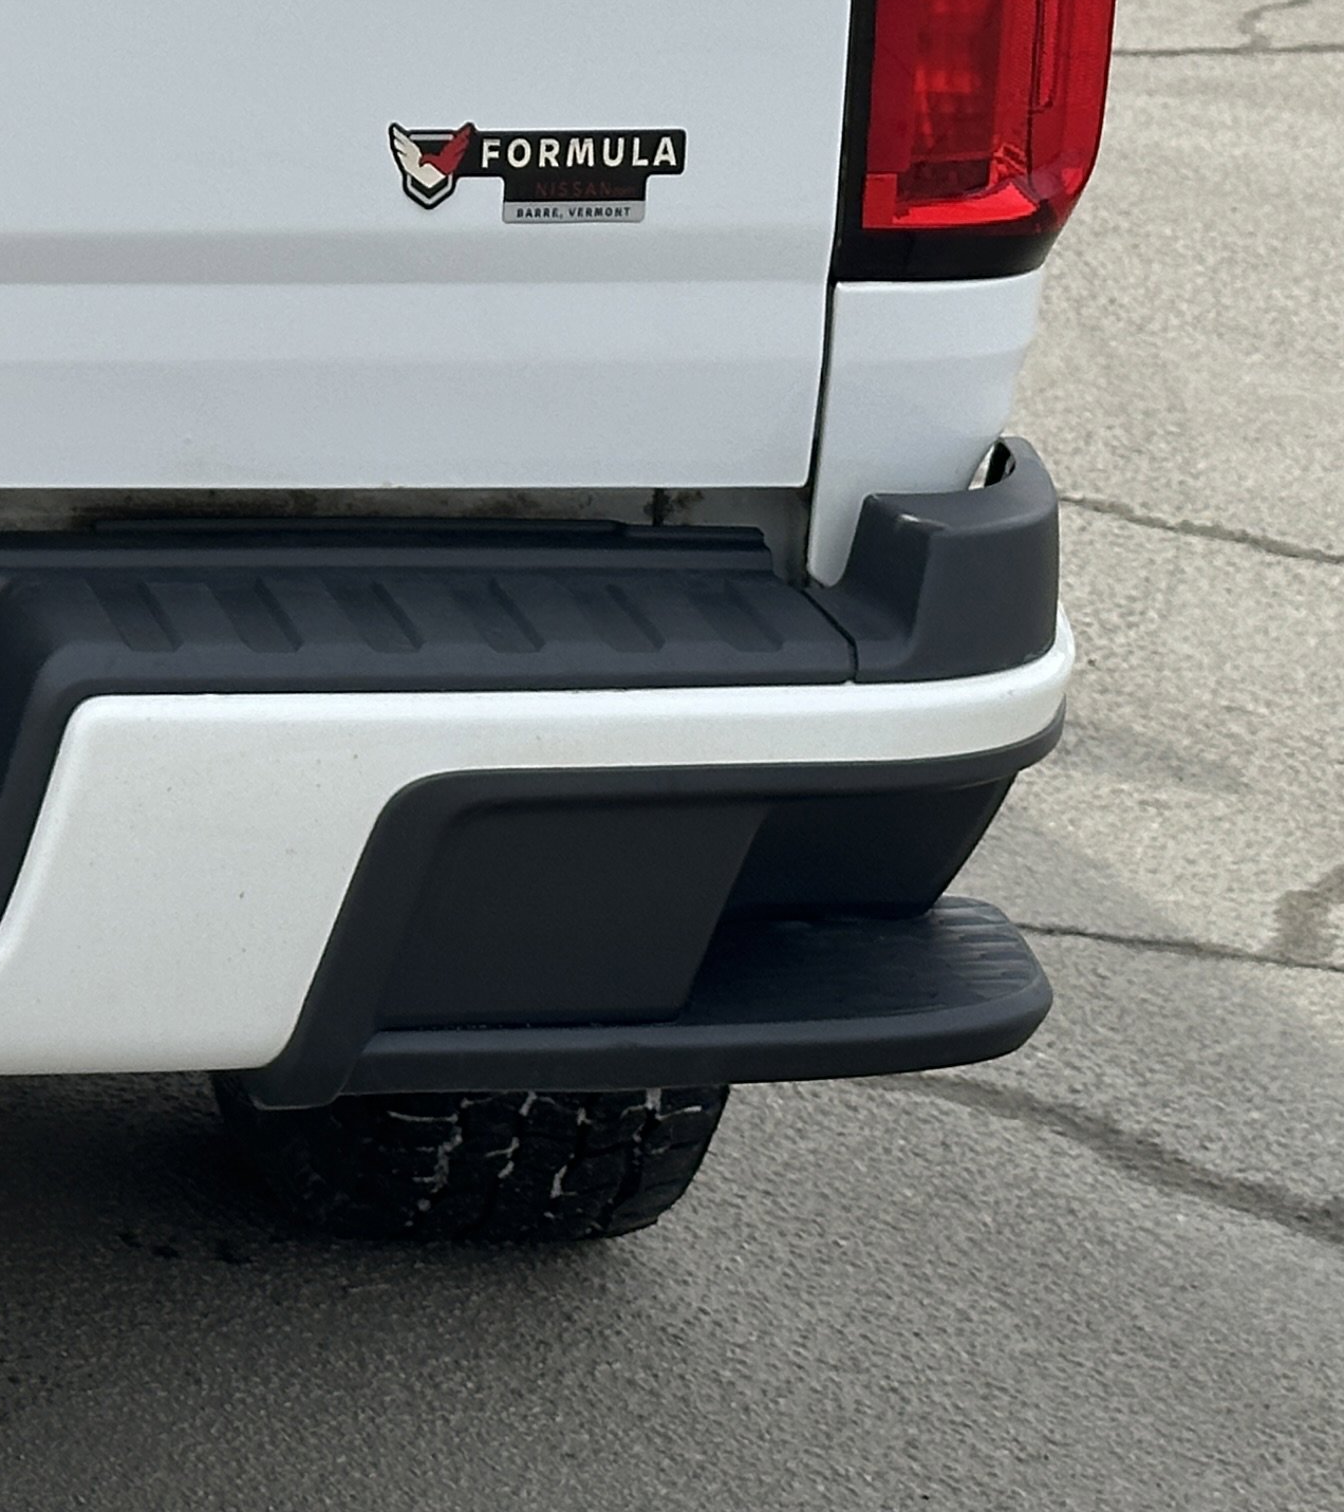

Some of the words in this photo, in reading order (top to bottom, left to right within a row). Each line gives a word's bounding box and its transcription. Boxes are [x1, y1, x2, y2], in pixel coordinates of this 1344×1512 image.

[481, 137, 677, 168] FORMULA
[516, 207, 563, 219] BARRE,
[568, 206, 631, 218] VERMONT
